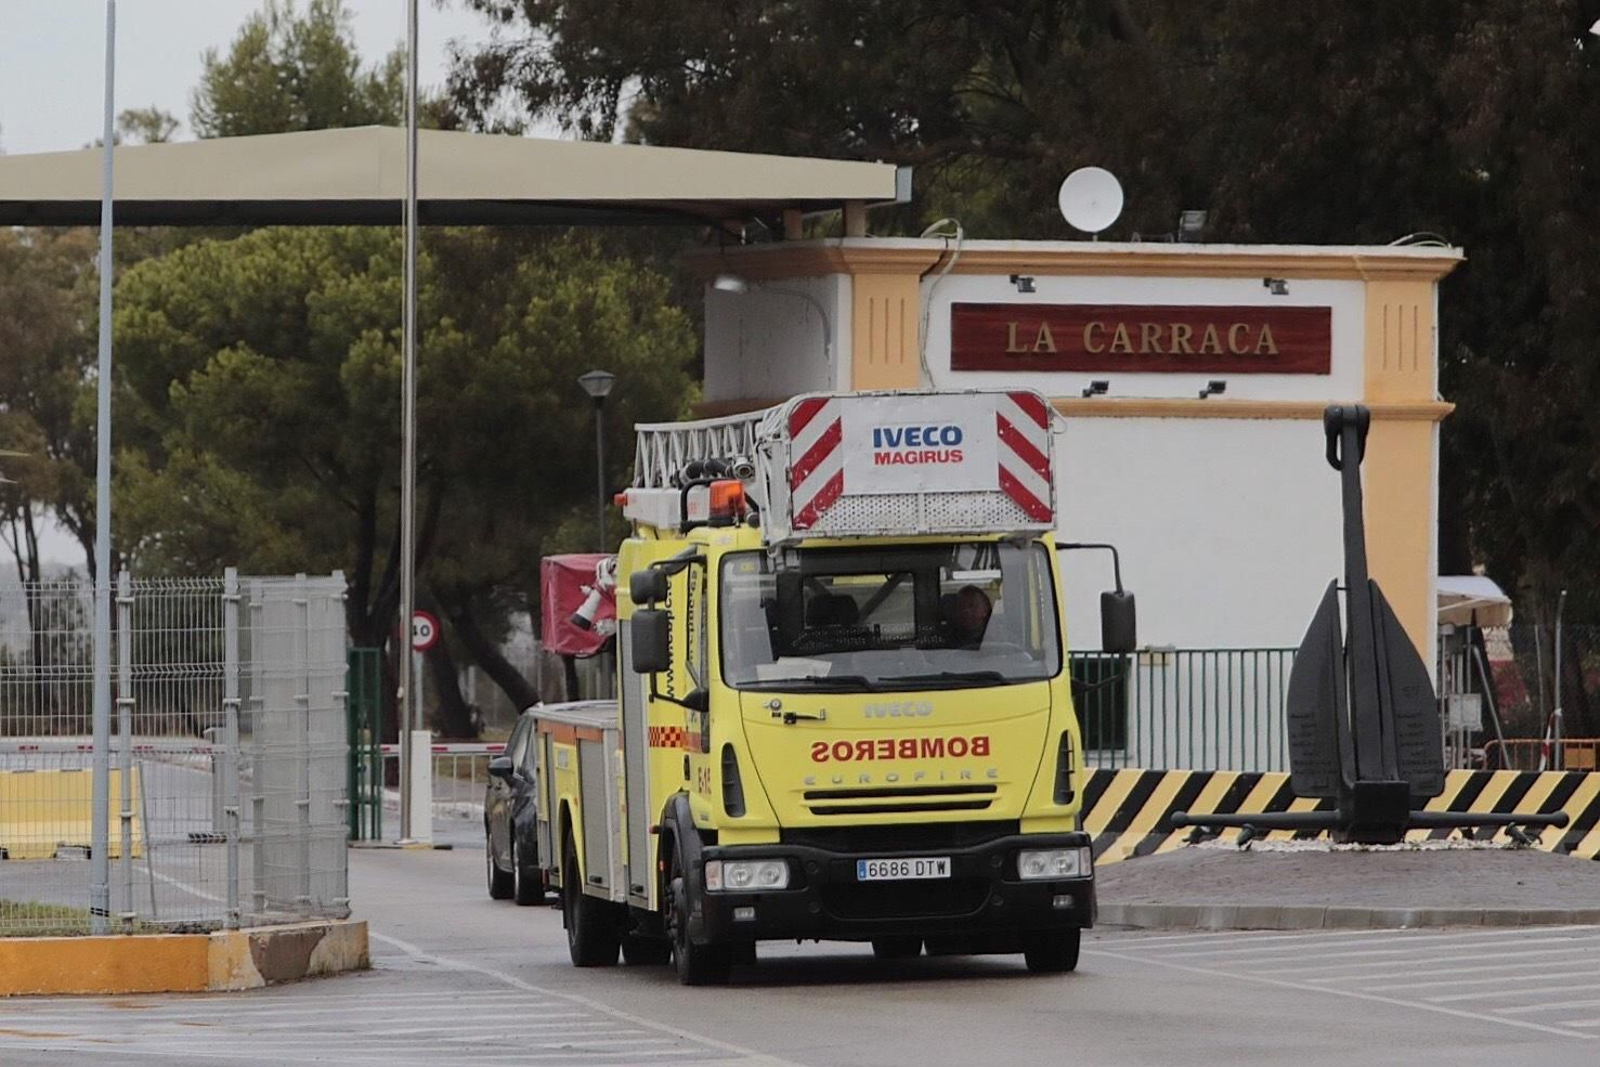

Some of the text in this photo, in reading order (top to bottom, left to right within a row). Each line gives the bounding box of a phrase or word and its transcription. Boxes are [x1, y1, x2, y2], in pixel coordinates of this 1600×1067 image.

[1005, 321, 1280, 355] LA CARRACA
[873, 425, 963, 448] IVECO
[874, 449, 964, 466] MAGIRUS
[864, 700, 933, 718] IVECO
[803, 768, 998, 786] EUROFIRE
[868, 860, 947, 877] 6686 DTW
